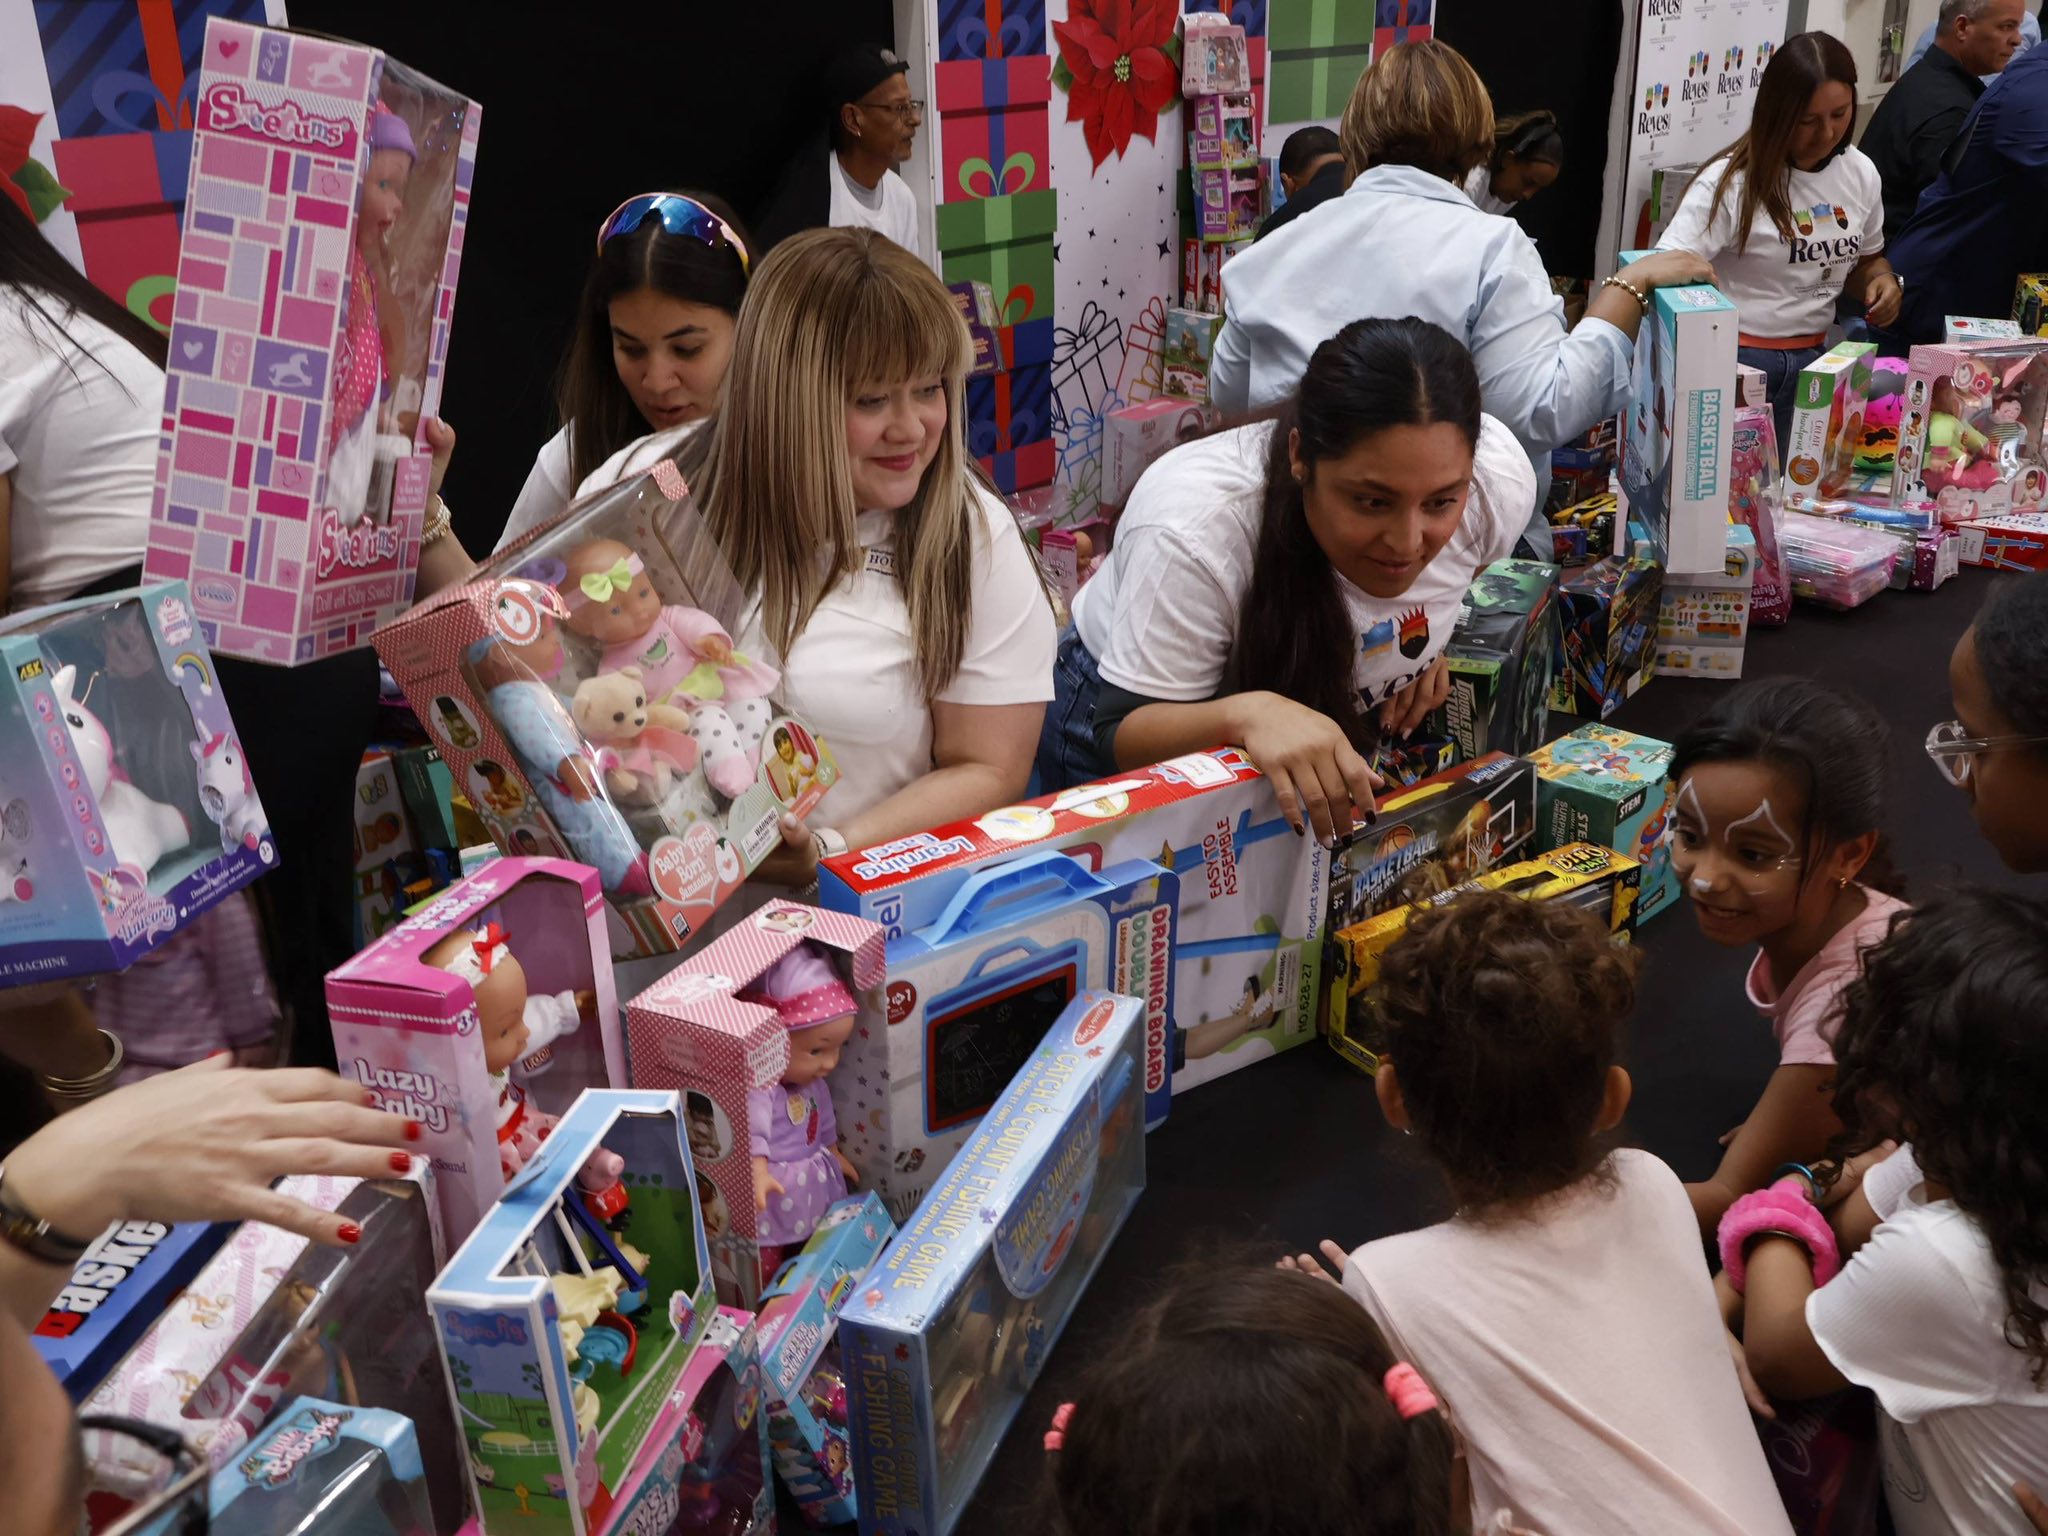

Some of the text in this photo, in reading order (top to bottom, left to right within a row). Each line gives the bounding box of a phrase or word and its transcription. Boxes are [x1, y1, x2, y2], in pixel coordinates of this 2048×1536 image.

[1638, 112, 1669, 139] Reyes
[1789, 234, 1859, 267] Reyes
[1698, 390, 1719, 499] BASKETBALL
[1751, 584, 1776, 597] airy
[1577, 811, 1588, 842] STE
[1619, 794, 1641, 819] STEM
[655, 827, 715, 876] Baby First
[852, 835, 976, 880] Learning
[860, 832, 941, 862] Easel
[1203, 834, 1223, 899] EASY TO
[1217, 817, 1237, 896] ASSEMBLE
[1558, 847, 1606, 871] DINO
[675, 858, 706, 885] Born
[1352, 831, 1439, 909] BASKETBALL
[117, 905, 175, 941] Unicorn
[1307, 894, 1319, 941] Product
[13, 955, 69, 973] MACHINE
[1146, 907, 1169, 1090] DRAWING BOARD
[355, 1058, 437, 1100] Lazy
[1030, 1053, 1080, 1101] CATCH
[981, 1116, 1036, 1173] COUNT
[932, 1174, 998, 1241] FISHING
[893, 1243, 947, 1290] GAME
[495, 1313, 528, 1343] Pig
[862, 1353, 899, 1520] FISHING GAME
